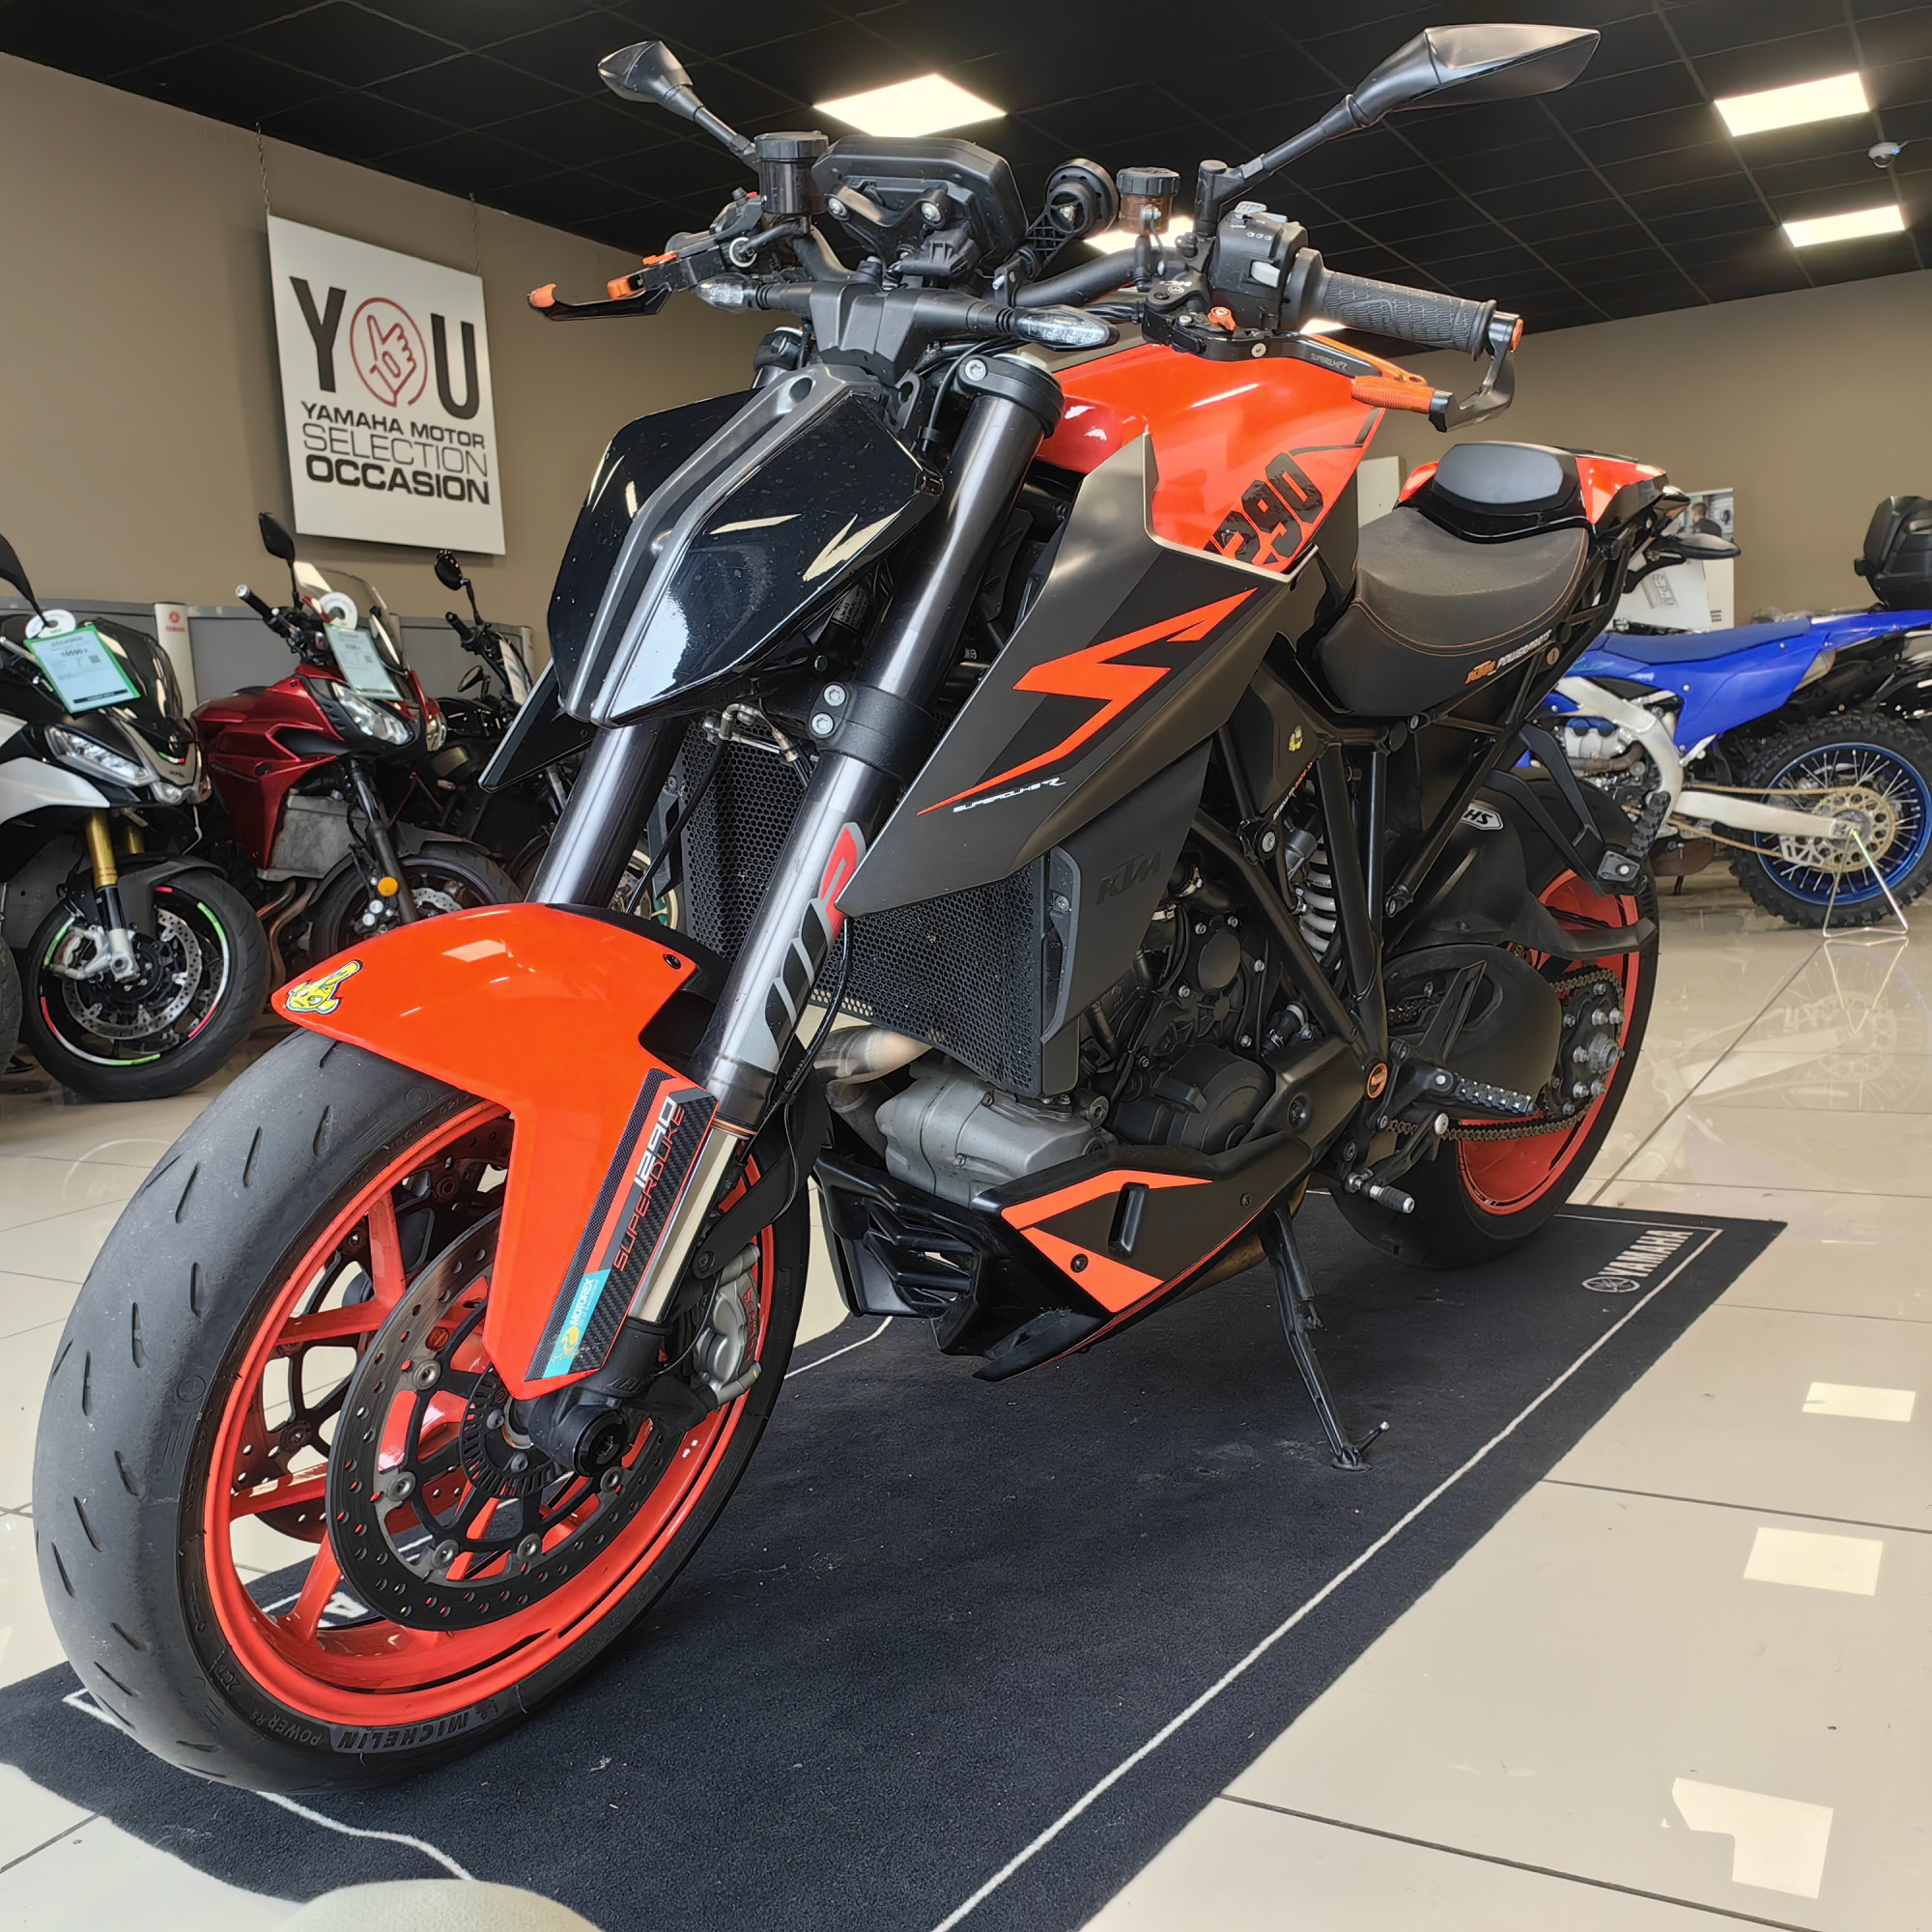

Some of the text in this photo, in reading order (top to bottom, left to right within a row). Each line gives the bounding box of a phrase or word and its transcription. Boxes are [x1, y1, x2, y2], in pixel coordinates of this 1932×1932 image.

[300, 400, 485, 449] YAMAHA MOTOR
[302, 422, 488, 477] SELECTION
[305, 454, 491, 505] OCCASION
[1095, 851, 1162, 906] KTM
[634, 1094, 677, 1189] 1290
[1597, 1230, 1694, 1278] YAMAHA
[569, 1277, 594, 1326] MOTOREX
[266, 1712, 322, 1747] POWER
[336, 1710, 470, 1750] MICHELIN
